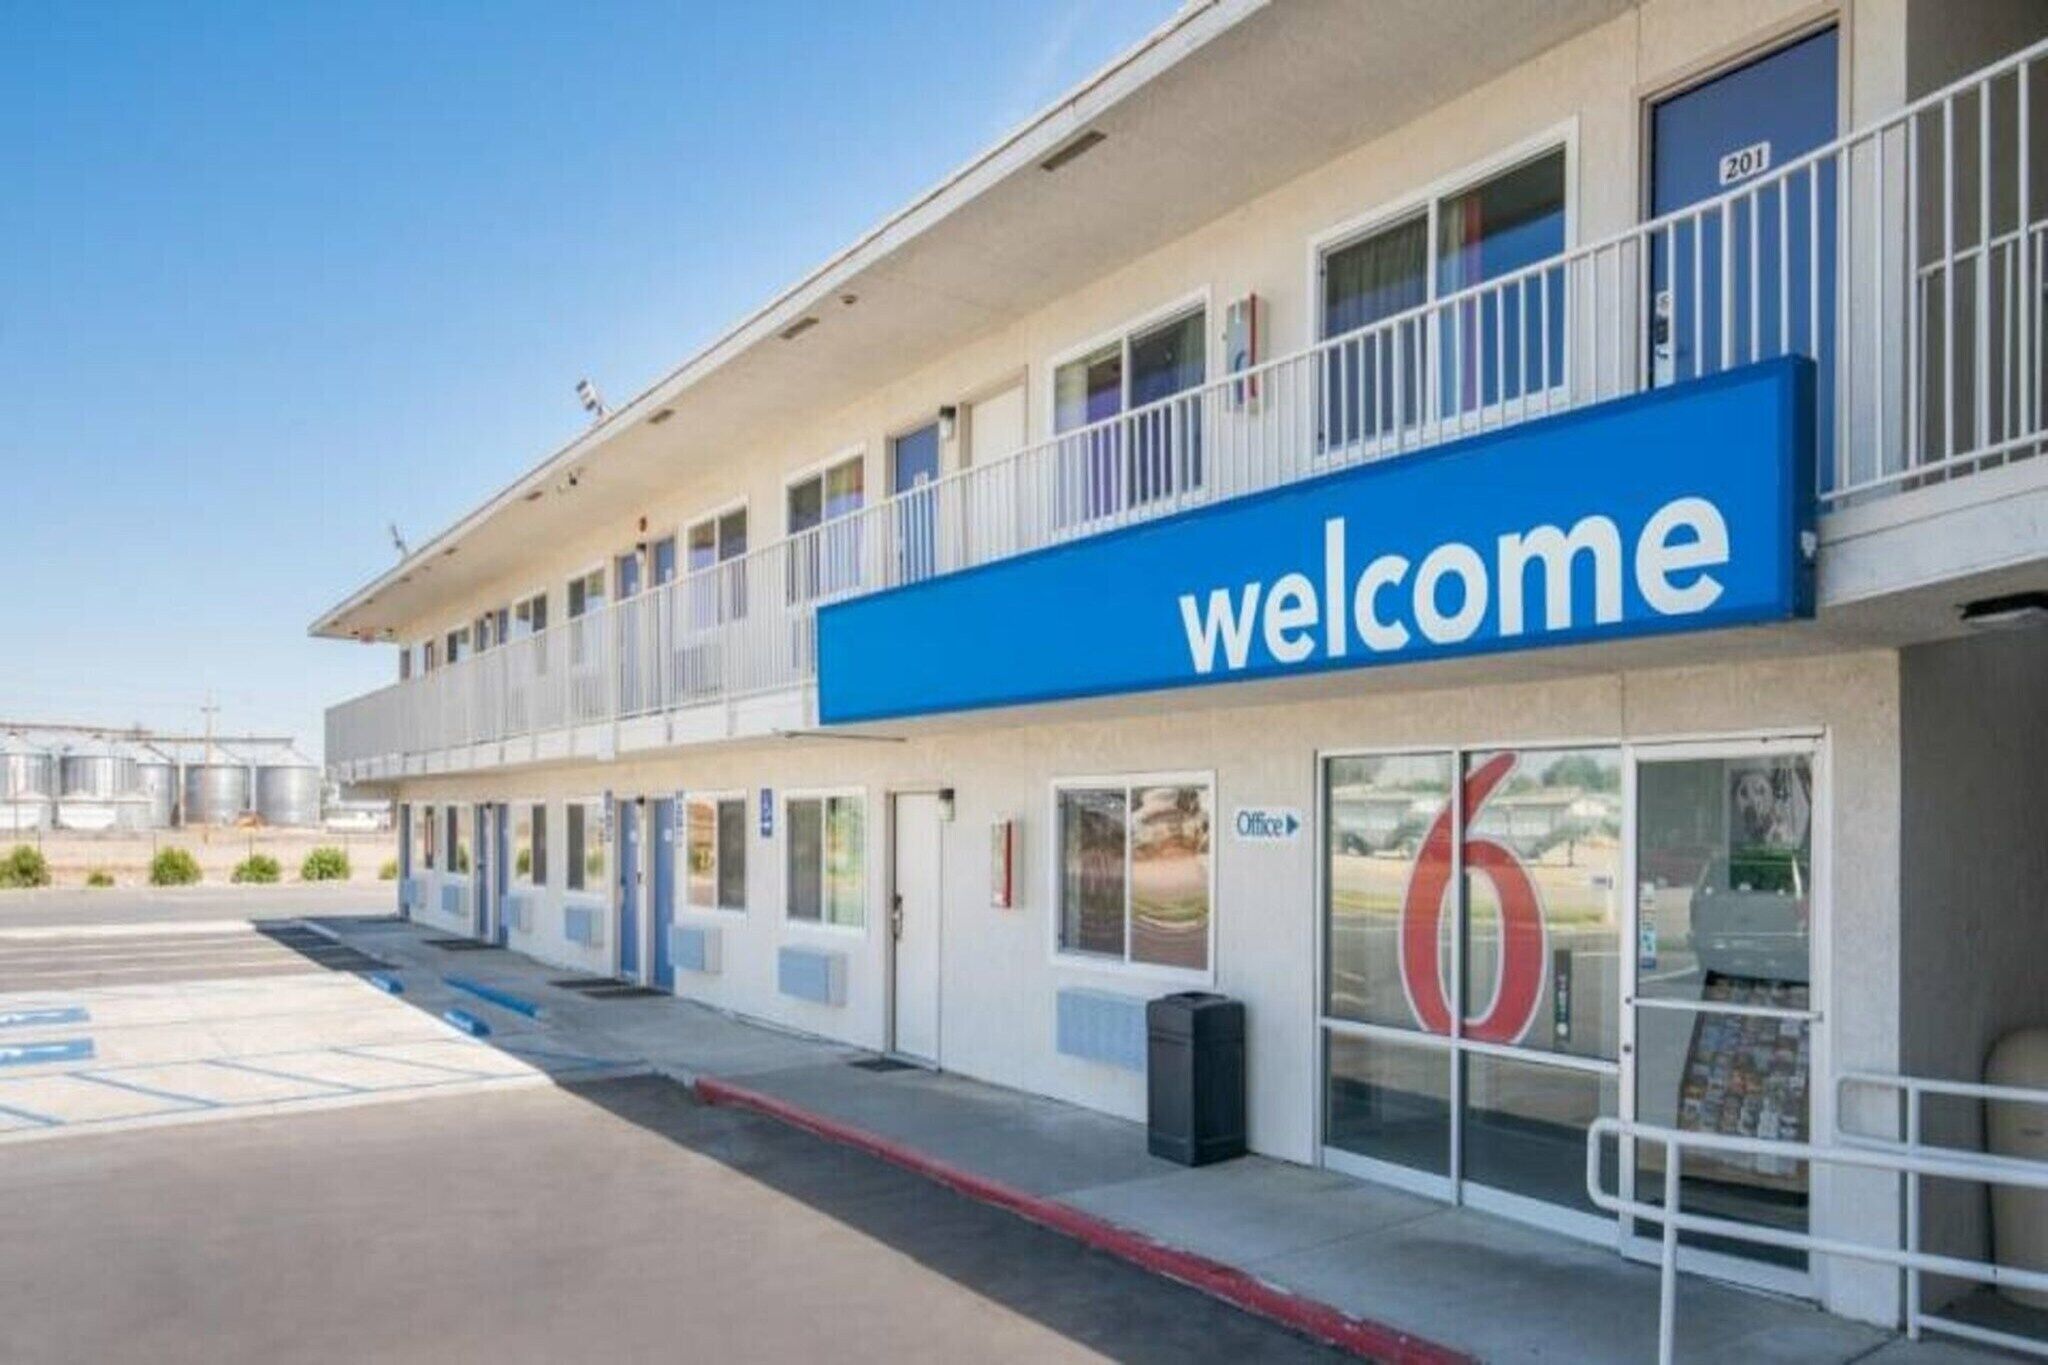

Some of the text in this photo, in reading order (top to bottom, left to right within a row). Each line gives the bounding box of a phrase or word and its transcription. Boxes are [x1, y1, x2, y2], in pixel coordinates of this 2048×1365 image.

[1727, 148, 1763, 179] 201
[1179, 497, 1729, 674] welcome
[1238, 811, 1283, 836] Office
[1401, 752, 1544, 1045] 6
